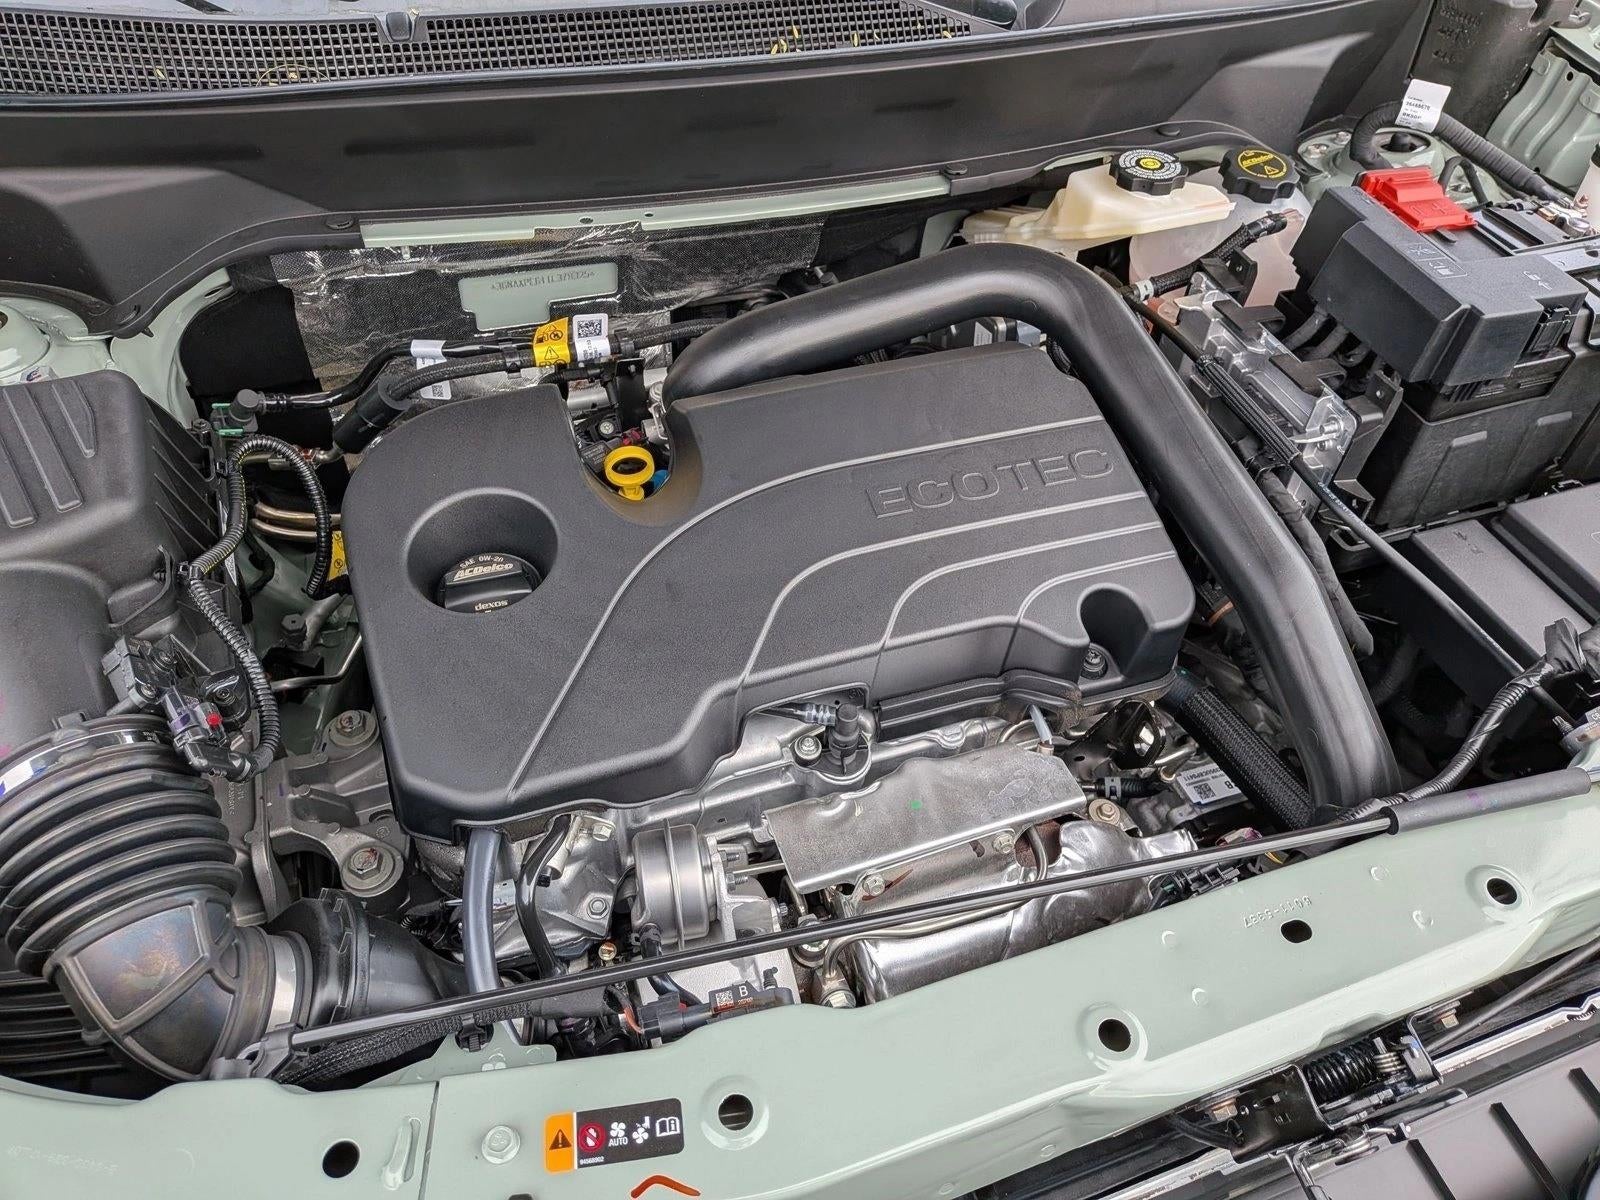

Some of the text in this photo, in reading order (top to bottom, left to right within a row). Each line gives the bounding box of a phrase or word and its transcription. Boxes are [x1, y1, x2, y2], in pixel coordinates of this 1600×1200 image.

[865, 449, 1114, 519] ECOTEC
[460, 558, 476, 569] SAE
[453, 563, 514, 582] ACDelco
[474, 600, 509, 611] dexos
[738, 985, 749, 998] B
[608, 1136, 628, 1148] AUTO
